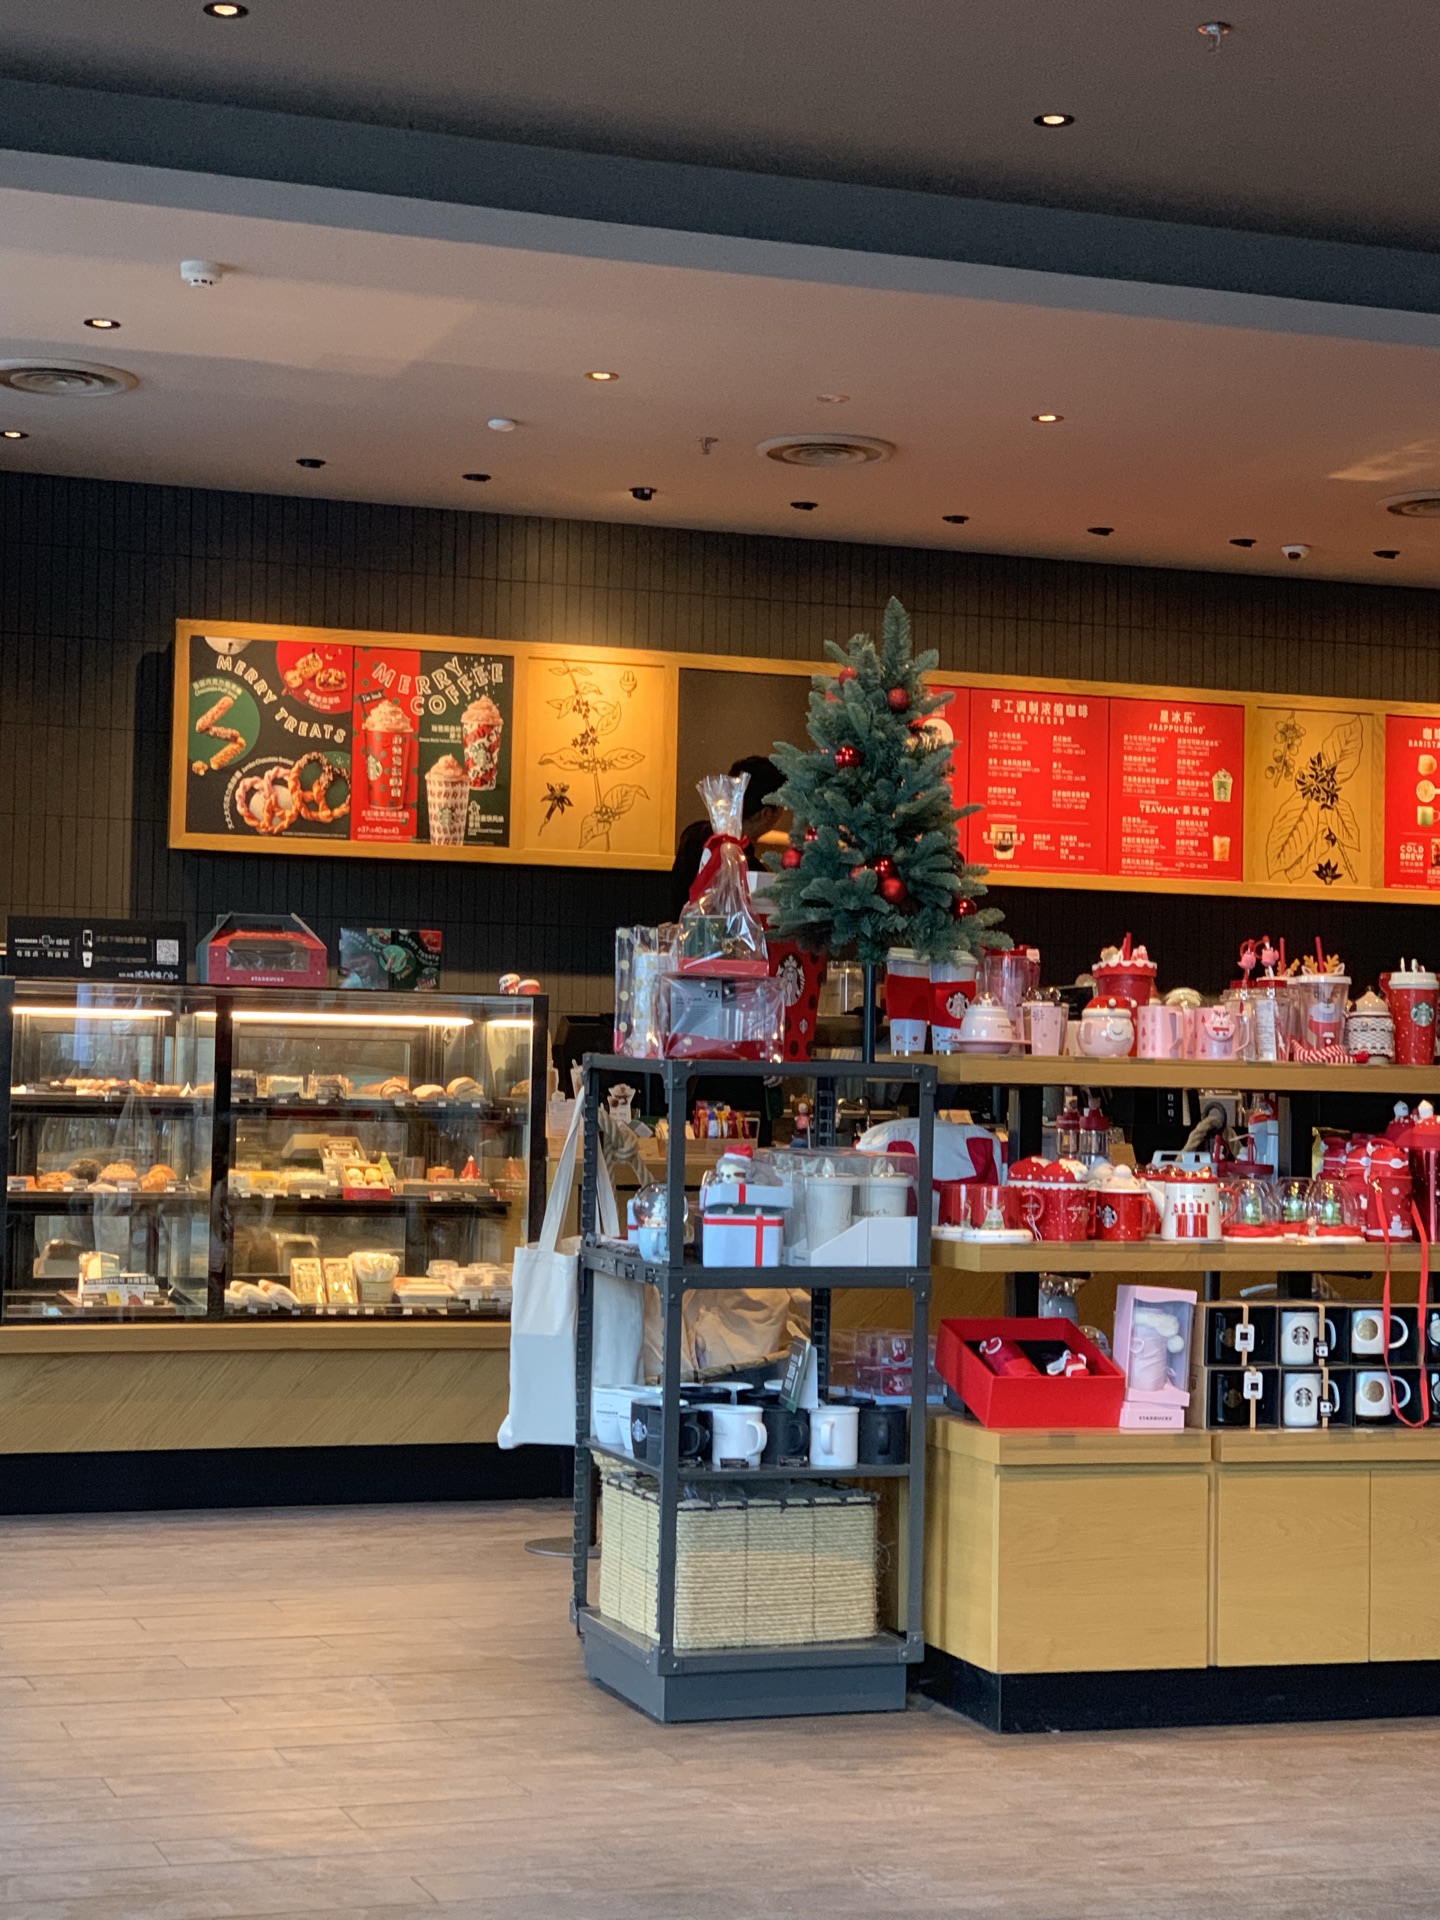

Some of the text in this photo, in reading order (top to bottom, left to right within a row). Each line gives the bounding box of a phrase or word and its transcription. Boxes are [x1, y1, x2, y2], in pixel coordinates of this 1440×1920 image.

[371, 656, 463, 696] MERRY
[410, 663, 504, 716] COFFEE
[216, 654, 278, 705] MERRY
[274, 706, 347, 744] TREATS
[991, 698, 1089, 718] 手工调制浓缩咖啡
[1013, 714, 1066, 726] ESPRESSO
[1159, 709, 1194, 725] 星冰乐
[1148, 723, 1204, 735] FRAPPUCCINO
[1139, 804, 1180, 815] TEAVANA
[1399, 844, 1424, 853] COLD
[1399, 852, 1424, 861] BREW
[706, 989, 719, 999] 71
